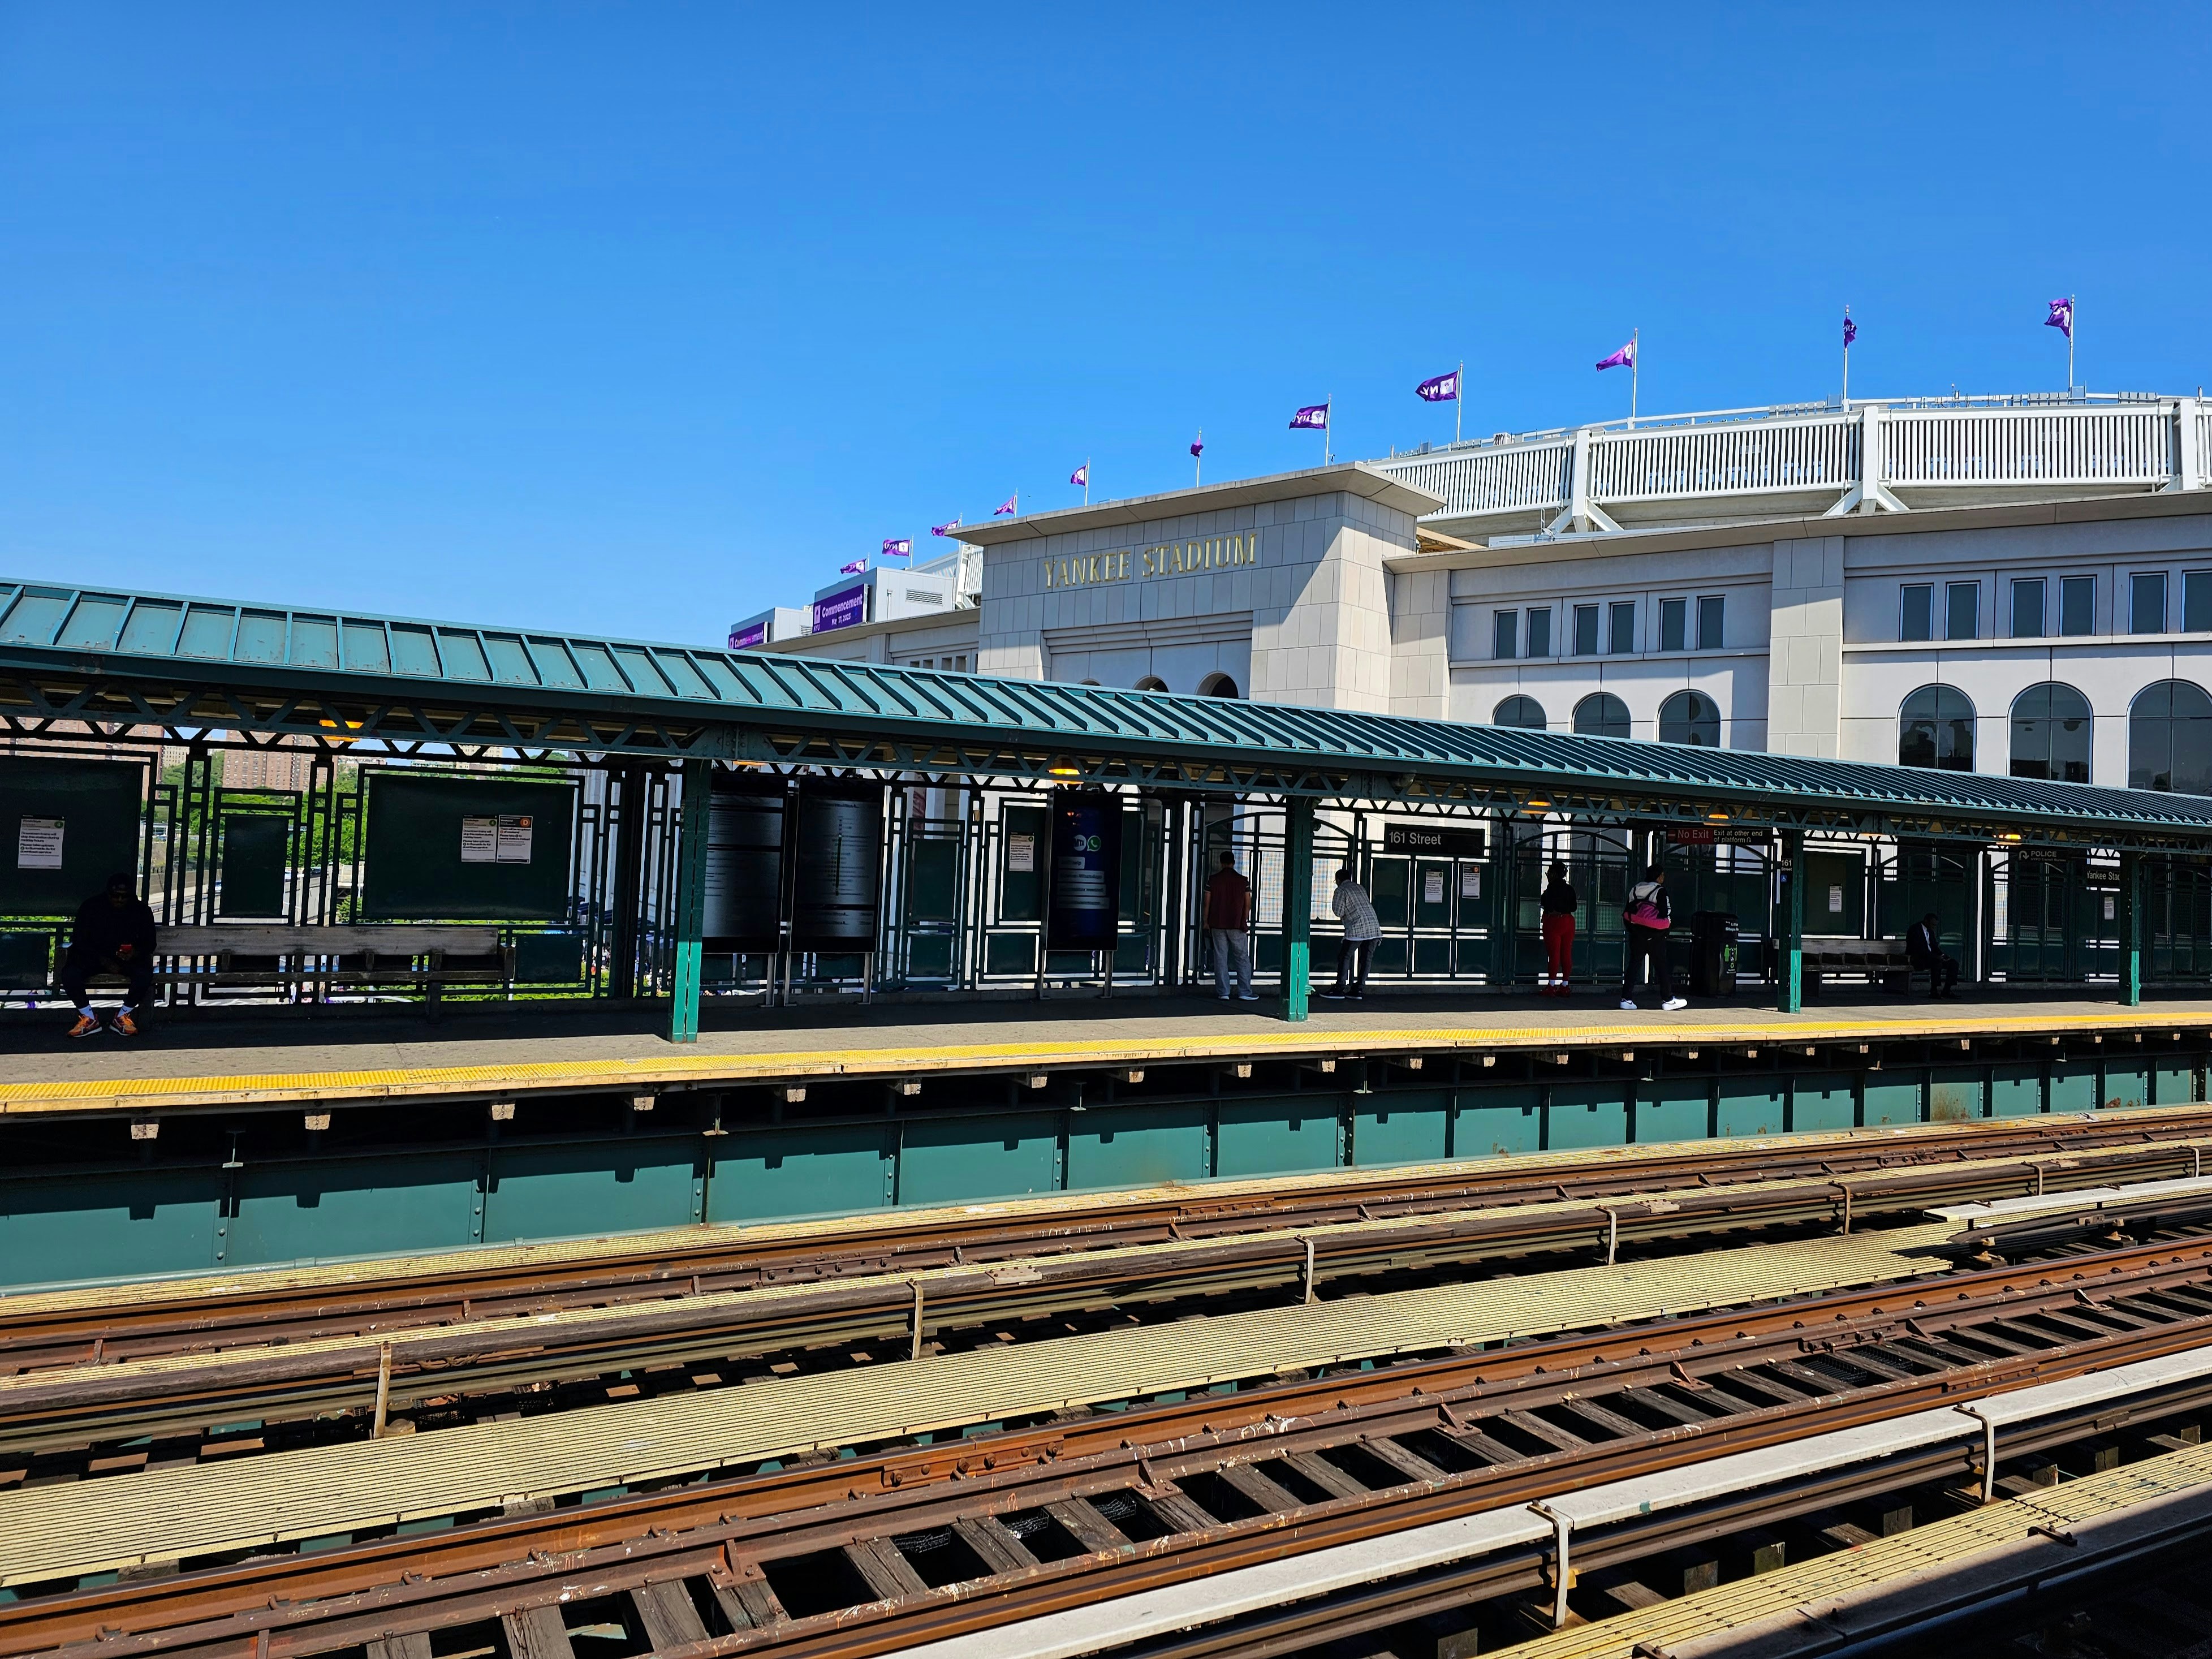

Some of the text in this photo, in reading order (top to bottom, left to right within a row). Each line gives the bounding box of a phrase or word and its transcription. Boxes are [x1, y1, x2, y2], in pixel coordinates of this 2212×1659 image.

[1044, 533, 1256, 588] YANKEE STADIUM
[822, 593, 863, 618] Commencement
[1389, 831, 1441, 844] 161 Street
[1678, 830, 1709, 838] No Exit
[2086, 870, 2107, 880] Yankee
